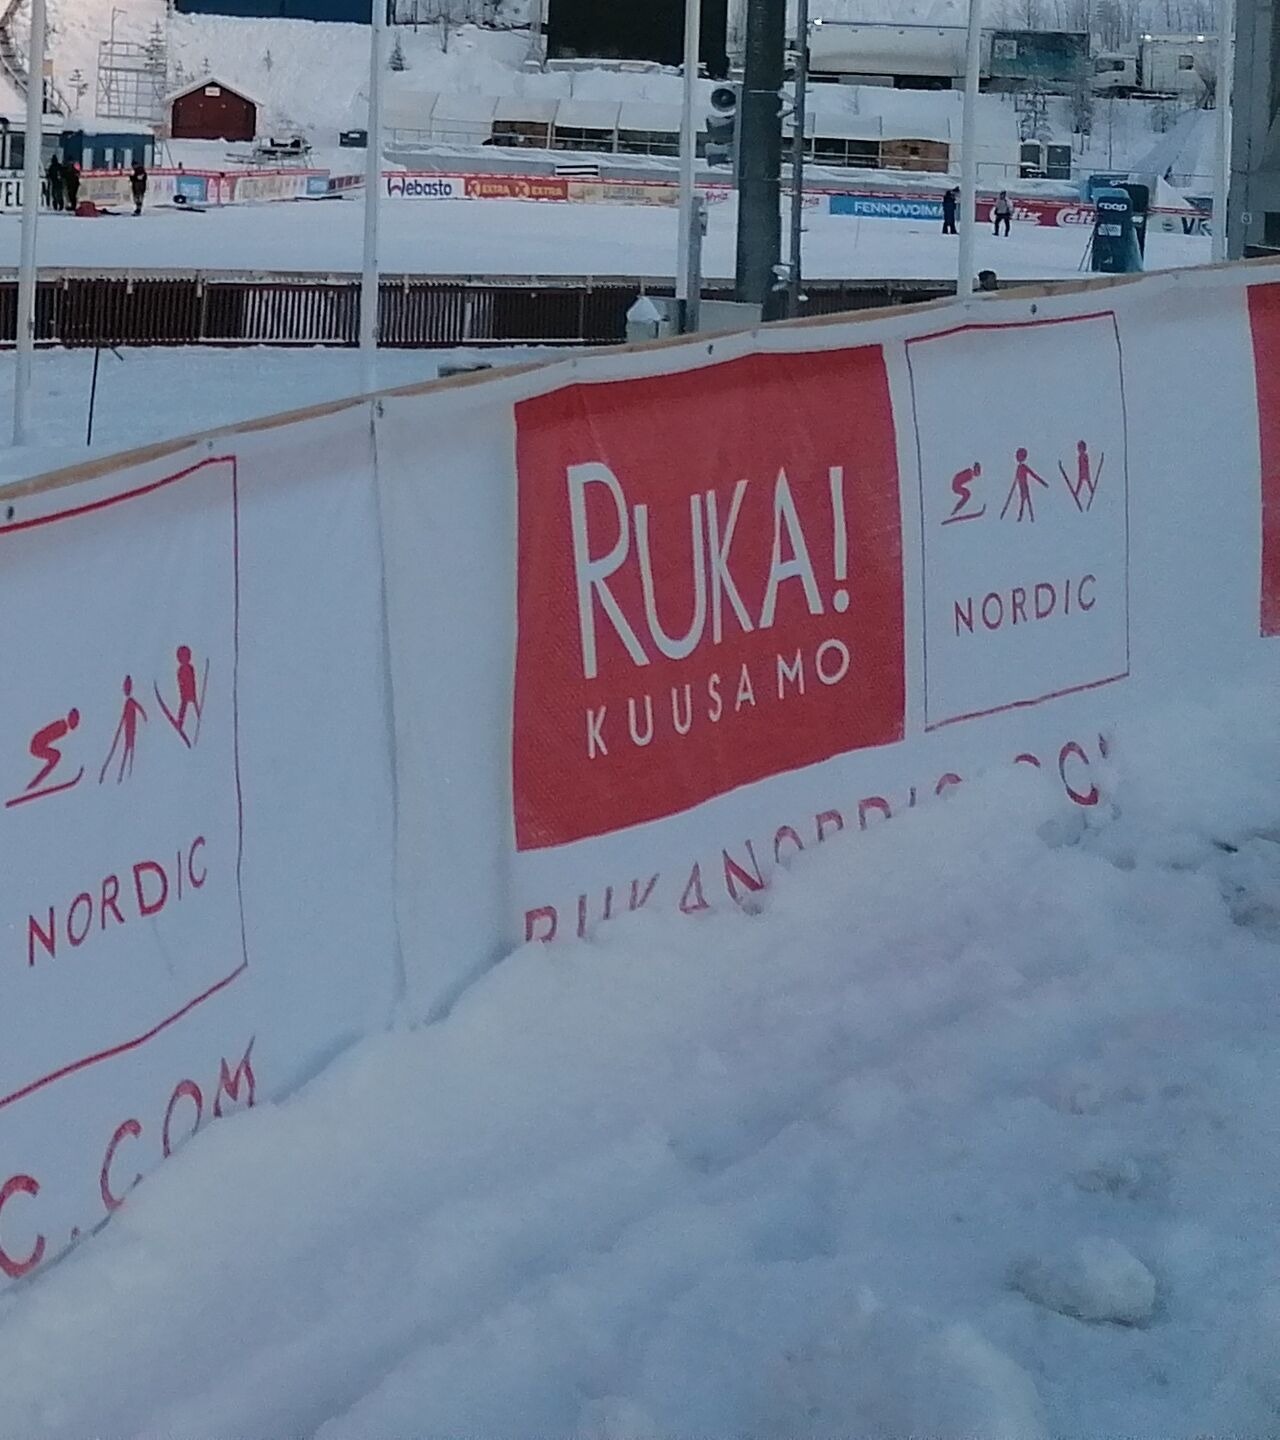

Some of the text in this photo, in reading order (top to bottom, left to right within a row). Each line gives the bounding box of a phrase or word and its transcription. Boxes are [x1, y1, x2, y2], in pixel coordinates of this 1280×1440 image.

[387, 177, 452, 197] Webasto
[1099, 202, 1127, 212] coop
[566, 461, 852, 678] RUKA!
[954, 574, 1096, 637] NORDIC
[585, 638, 851, 759] KUUSAMO
[28, 835, 207, 966] NORDIC
